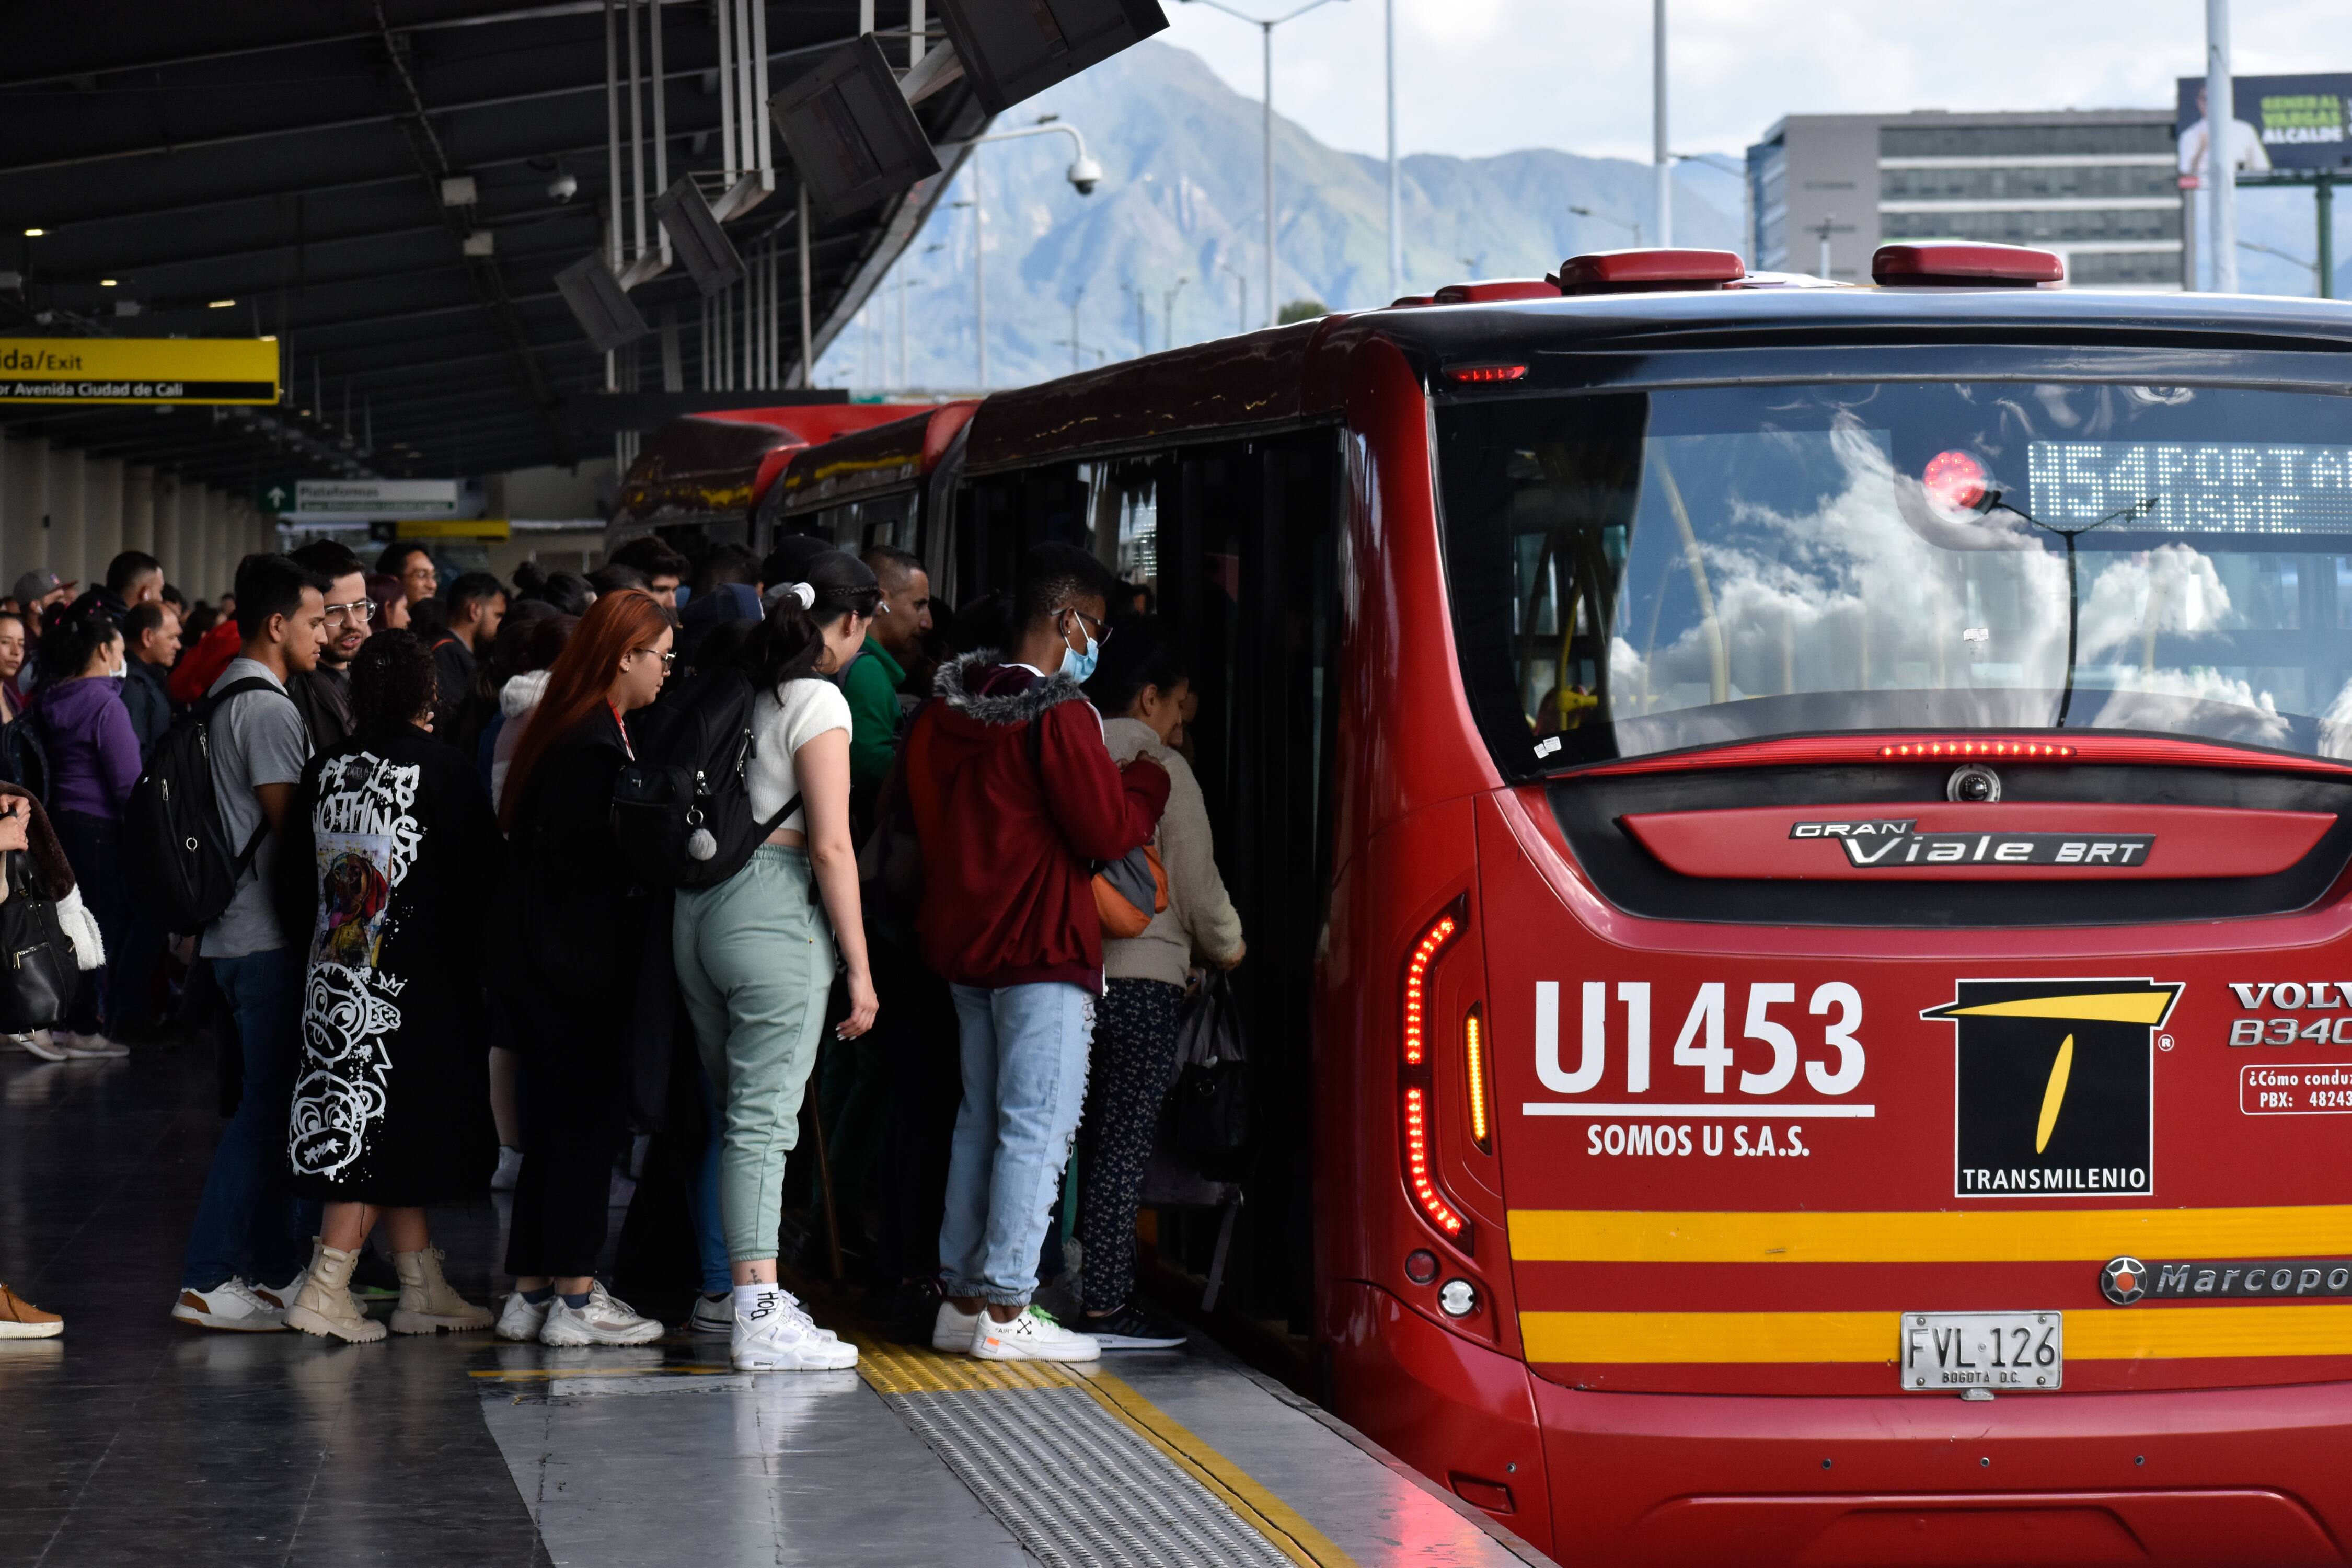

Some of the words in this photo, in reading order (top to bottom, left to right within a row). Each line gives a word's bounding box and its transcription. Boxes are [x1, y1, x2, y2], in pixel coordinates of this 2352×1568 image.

[14, 382, 75, 396] Avenida
[78, 382, 130, 396] Ciudad
[133, 383, 153, 396] de
[156, 382, 183, 396] Cali
[2028, 445, 2146, 517] H54
[2158, 447, 2352, 487] PORTA
[2160, 493, 2301, 533] USME
[1795, 823, 1907, 837] GRAN
[1846, 836, 2034, 863] Viale
[2054, 842, 2145, 863] BRT
[1535, 981, 1866, 1095] U1453
[2249, 1070, 2298, 1086] ¿Cómo
[2259, 1092, 2293, 1108] PBX:
[1587, 1124, 1692, 1156] SOMOS
[1703, 1125, 1723, 1156] U
[1734, 1125, 1811, 1157] S.A.S.
[1963, 1168, 2146, 1190] TRANSMILENIO
[2156, 1264, 2349, 1294] Marcopo
[1908, 1327, 1976, 1368] FVL
[1991, 1326, 2055, 1367] 126
[1942, 1371, 1990, 1383] BOGOTA
[2000, 1371, 2021, 1383] D.C.
